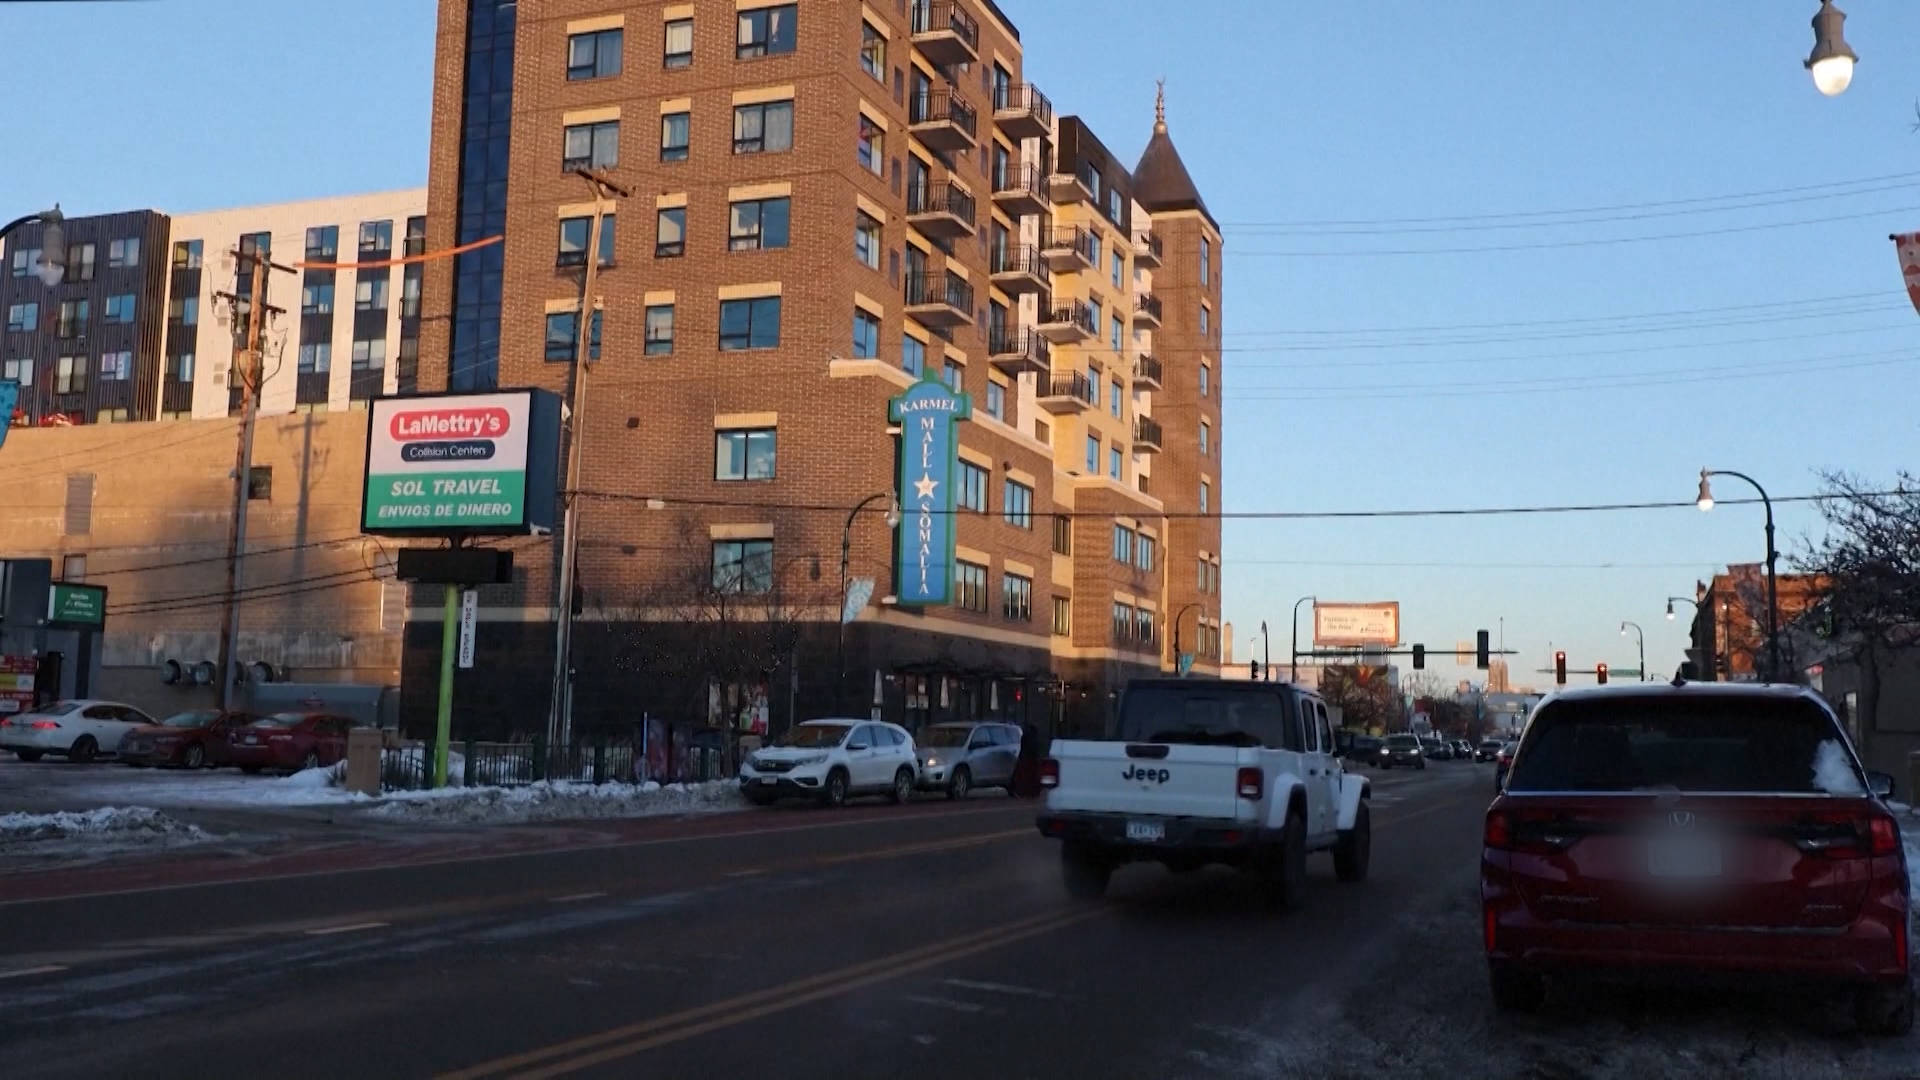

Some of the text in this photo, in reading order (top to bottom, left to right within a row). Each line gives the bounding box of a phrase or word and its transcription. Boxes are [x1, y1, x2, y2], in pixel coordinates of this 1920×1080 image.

[900, 399, 958, 414] KARMEL
[398, 413, 501, 436] LaMettry's
[409, 445, 487, 458] Collision Centers
[920, 417, 935, 469] MALL
[391, 478, 502, 497] SOL TRAVEL
[378, 503, 513, 518] ENVIOS DE DINERO
[919, 503, 931, 595] SOMALIA
[1121, 764, 1171, 784] Jeep
